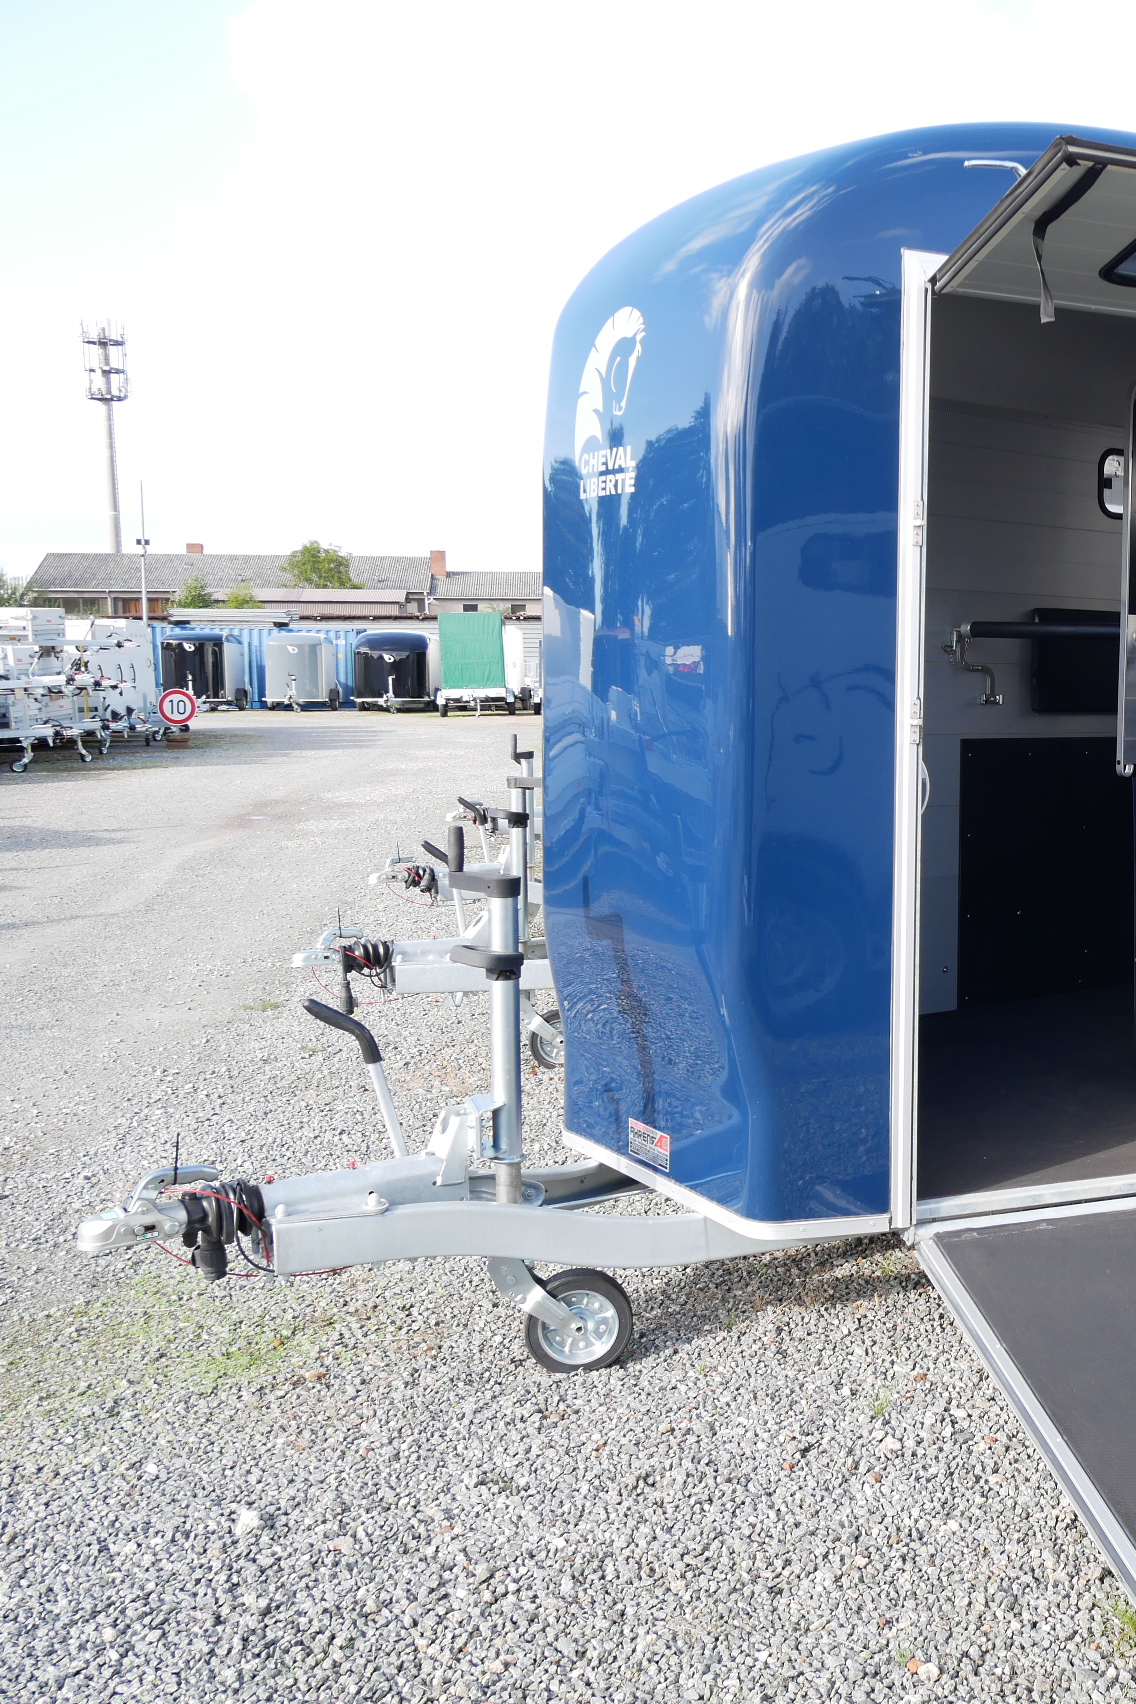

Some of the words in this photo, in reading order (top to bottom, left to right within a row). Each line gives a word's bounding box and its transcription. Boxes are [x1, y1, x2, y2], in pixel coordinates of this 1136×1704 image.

[580, 446, 636, 475] CHEVAL
[579, 467, 635, 500] LIBERTÉ
[168, 699, 187, 715] 10
